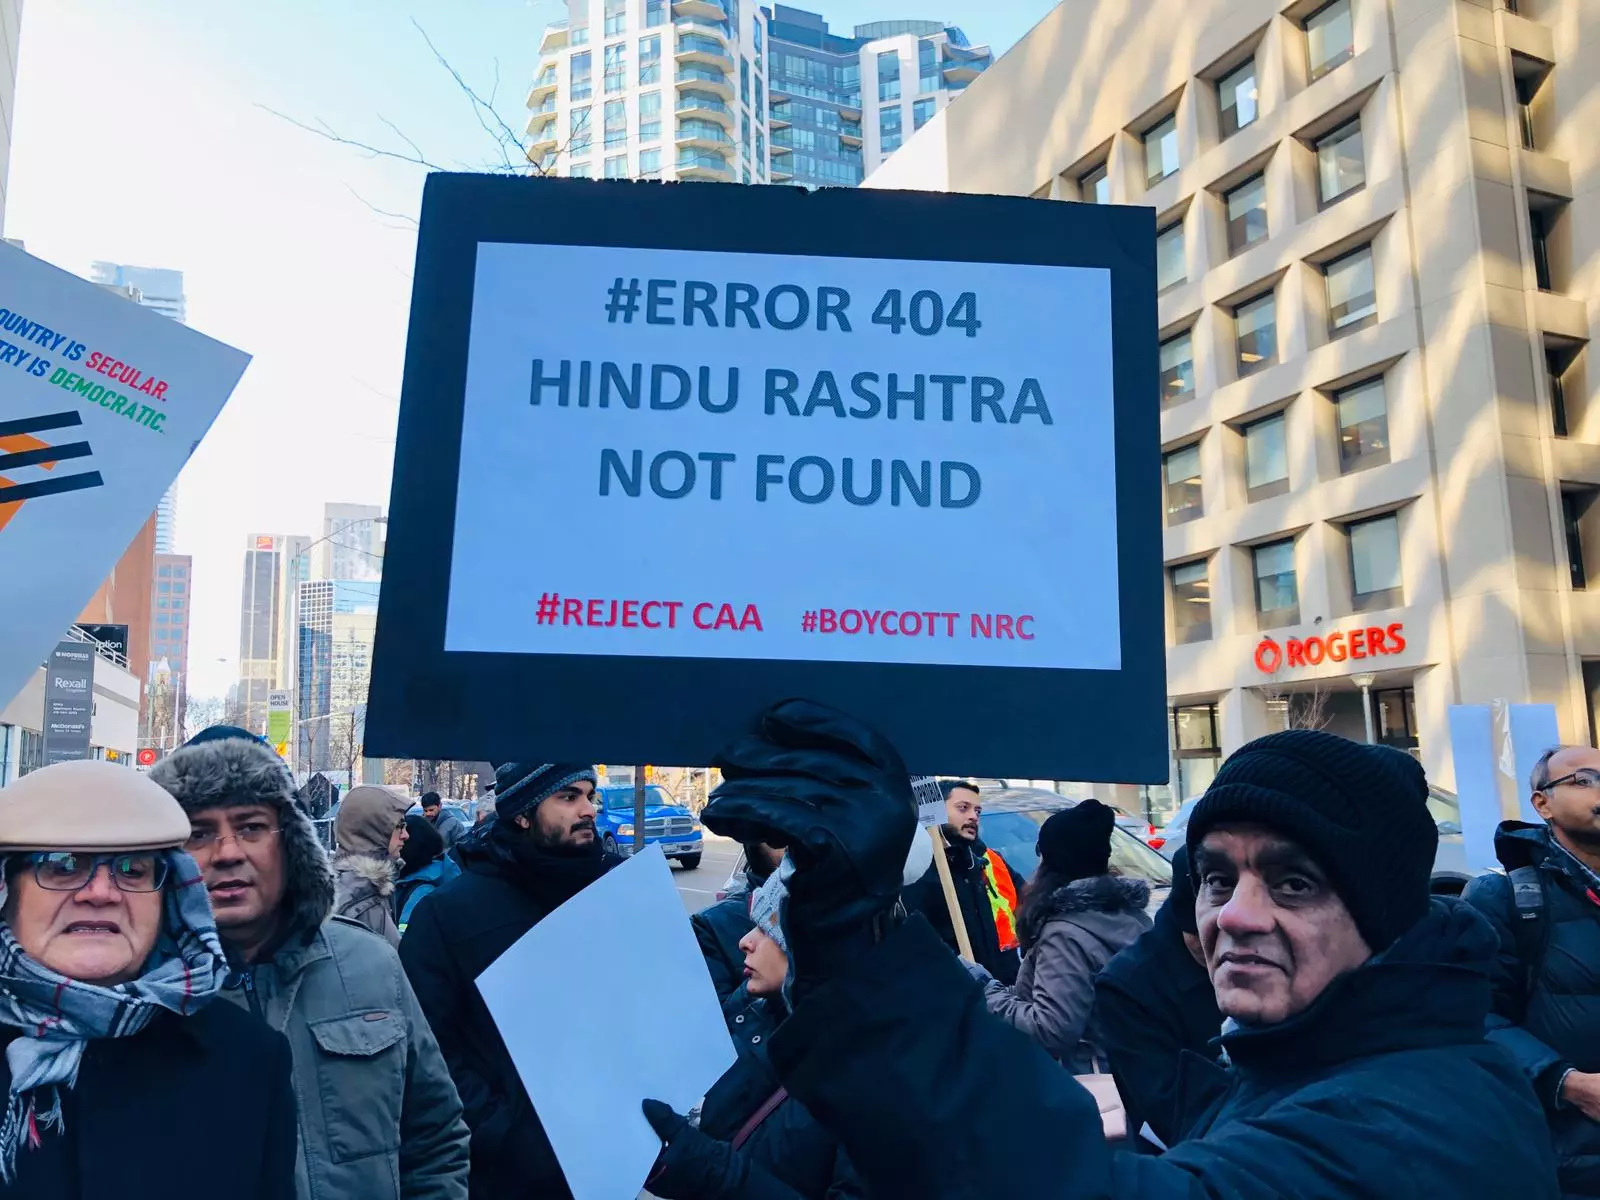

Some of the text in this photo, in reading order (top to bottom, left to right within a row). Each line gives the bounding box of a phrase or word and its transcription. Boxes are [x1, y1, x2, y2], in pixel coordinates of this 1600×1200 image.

[604, 277, 982, 338] #ERROR 404
[25, 356, 51, 377] IS
[48, 367, 167, 434] DEMOCRATIC.
[62, 340, 87, 361] IS
[85, 351, 169, 402] SECULAR.
[529, 358, 1054, 426] HINDU RASHTRA
[598, 448, 982, 509] NOT FOUND
[536, 593, 1036, 641] #REJECT CAA #BOYCOTT NRC
[1285, 622, 1407, 668] ROGERS
[55, 677, 87, 689] Rexall
